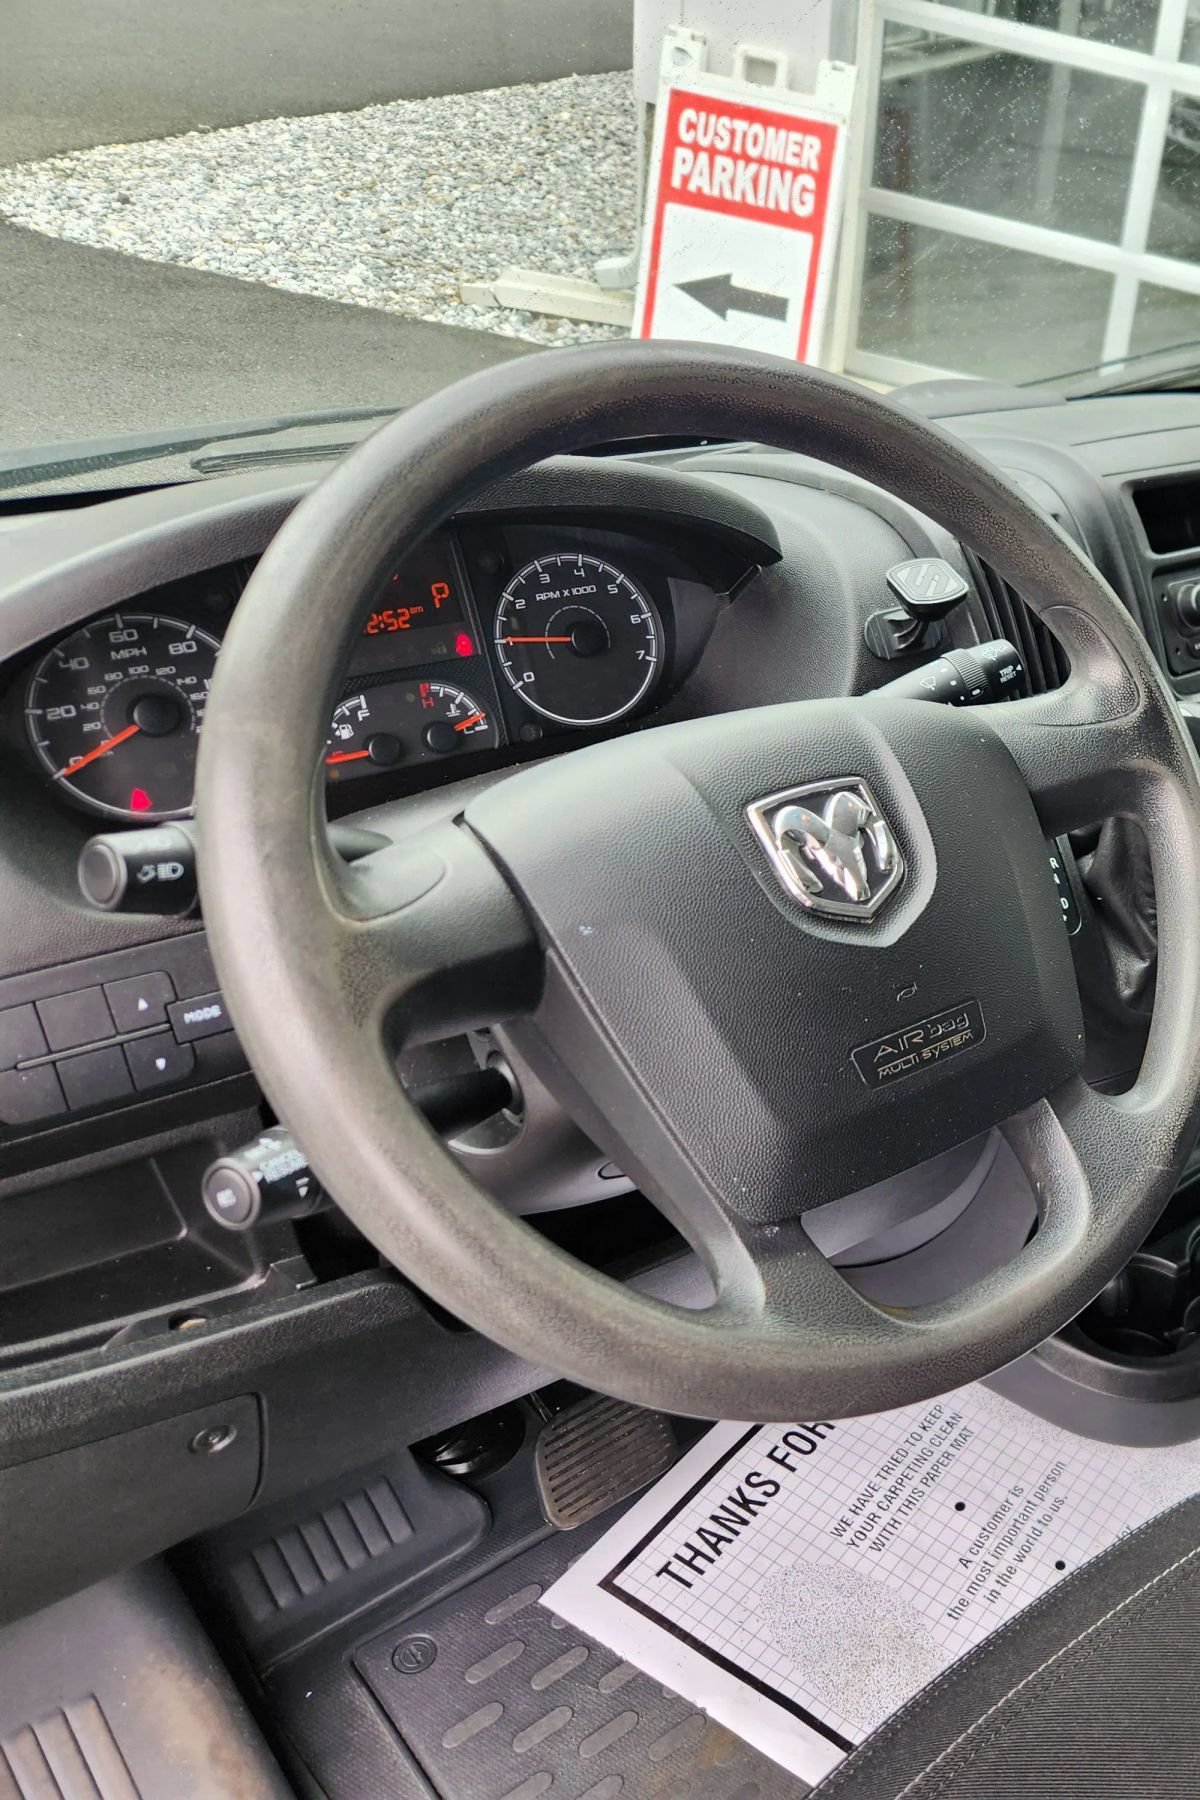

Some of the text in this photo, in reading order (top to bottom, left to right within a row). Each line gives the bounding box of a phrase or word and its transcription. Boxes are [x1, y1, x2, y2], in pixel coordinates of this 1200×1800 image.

[678, 108, 821, 172] CUSTOMER
[671, 147, 816, 217] PARKING
[539, 573, 550, 584] 3
[574, 568, 585, 578] 4
[431, 583, 449, 608] P
[536, 584, 597, 601] RPM X 1000
[607, 584, 618, 594] 5
[515, 599, 526, 610] 2
[365, 608, 410, 634] 2:52
[630, 614, 641, 625] 6
[109, 629, 139, 643] 60
[111, 646, 147, 660] MPH
[169, 641, 198, 655] 80
[636, 650, 646, 660] 7
[59, 657, 90, 670] 40
[128, 665, 150, 675] 100
[104, 672, 123, 681] 80
[156, 666, 176, 676] 120
[523, 671, 535, 683] 0
[999, 665, 1014, 677] TRIP
[177, 676, 197, 686] 140
[46, 704, 77, 720] 20
[80, 702, 99, 711] 40
[357, 709, 370, 722] F
[83, 722, 102, 732] 20
[1049, 857, 1060, 870] R
[1060, 897, 1069, 909] D
[184, 1004, 222, 1024] MODE
[830, 1404, 944, 1538] WE HAVE TRIED TO KEEP
[847, 1412, 963, 1550] YOUR CARPETING CLEAN
[868, 1425, 975, 1553] WITH THIS PAPER MAT
[655, 1472, 781, 1589] THANKS
[958, 1485, 1024, 1569] A customer is
[947, 1461, 1066, 1620] the most important person
[984, 1496, 1068, 1604] in the world to us.
